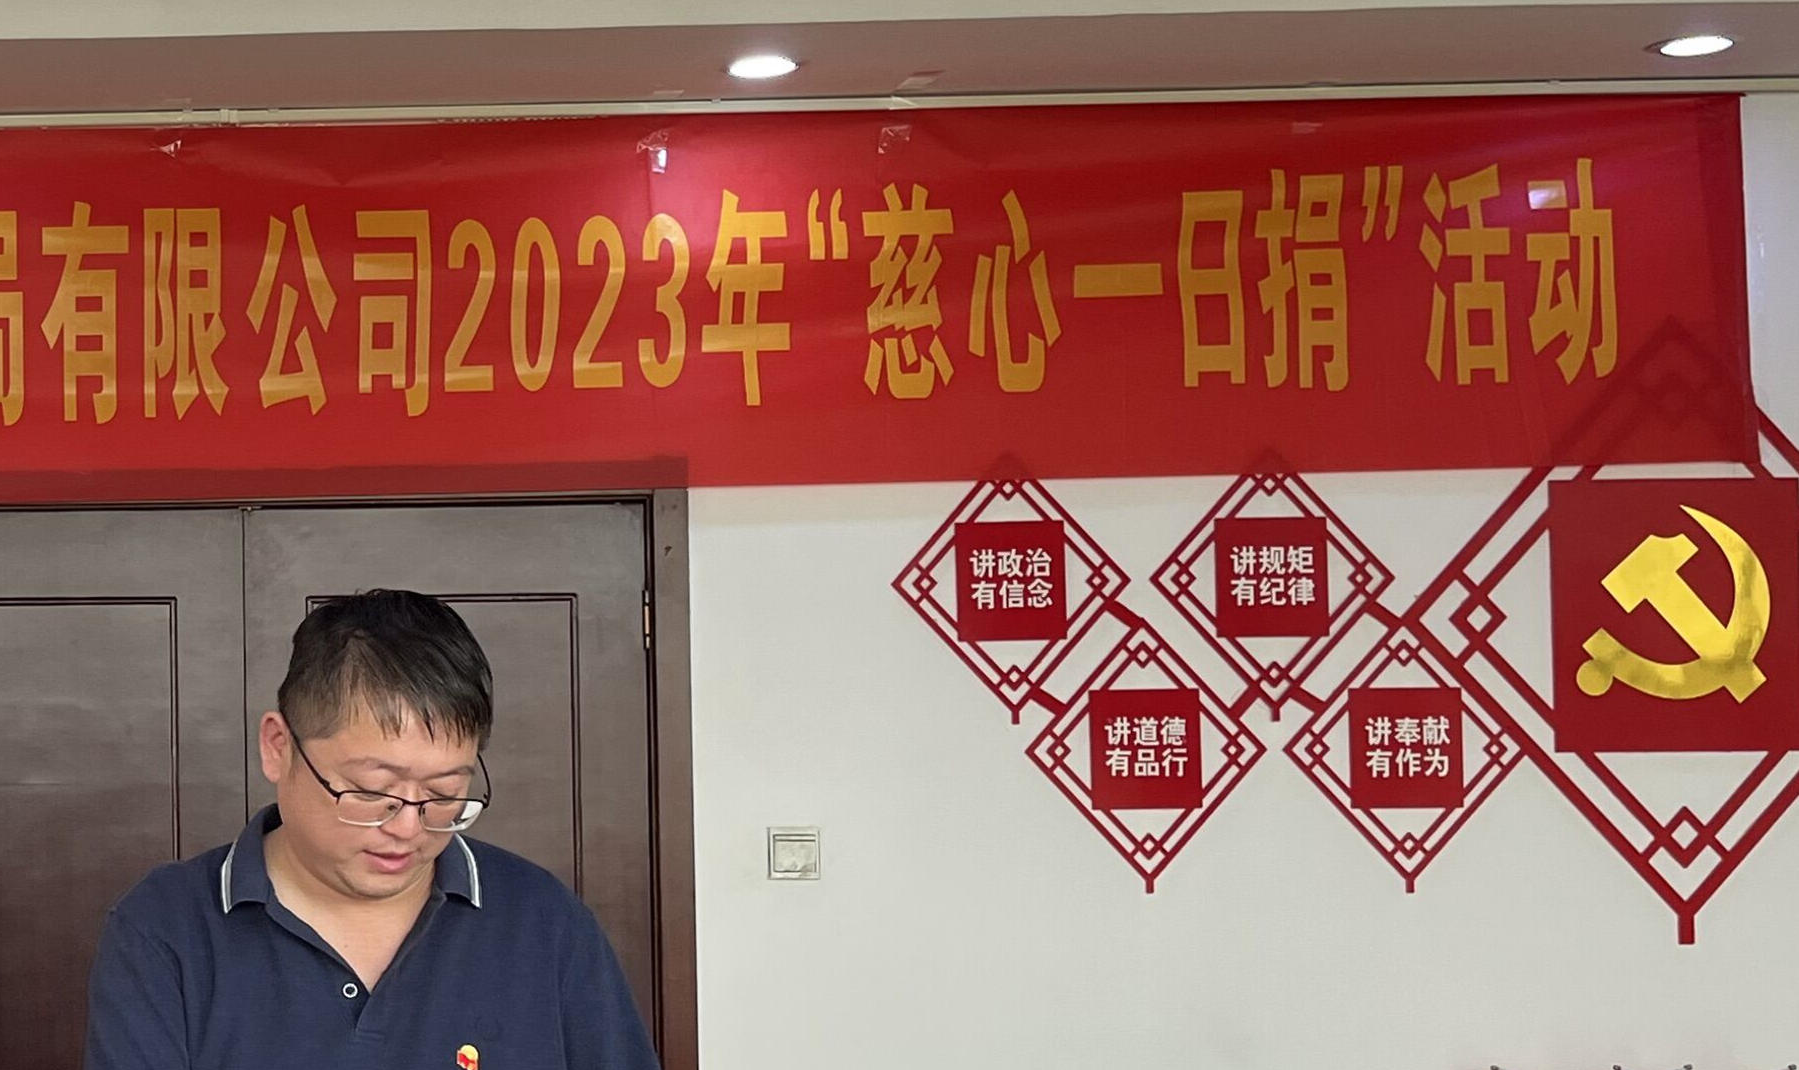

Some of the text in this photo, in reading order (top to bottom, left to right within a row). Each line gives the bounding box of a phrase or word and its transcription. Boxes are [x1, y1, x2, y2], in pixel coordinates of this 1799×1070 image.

[969, 547, 1052, 579] 讲政治
[1229, 544, 1316, 575] 讲规矩
[971, 578, 1053, 610] 有信念
[1230, 576, 1316, 606] 有纪律
[1104, 715, 1187, 746] 讲道德
[1365, 714, 1451, 746] 讲奉献
[1105, 747, 1189, 778] 有品行
[1366, 747, 1450, 778] 有作为
